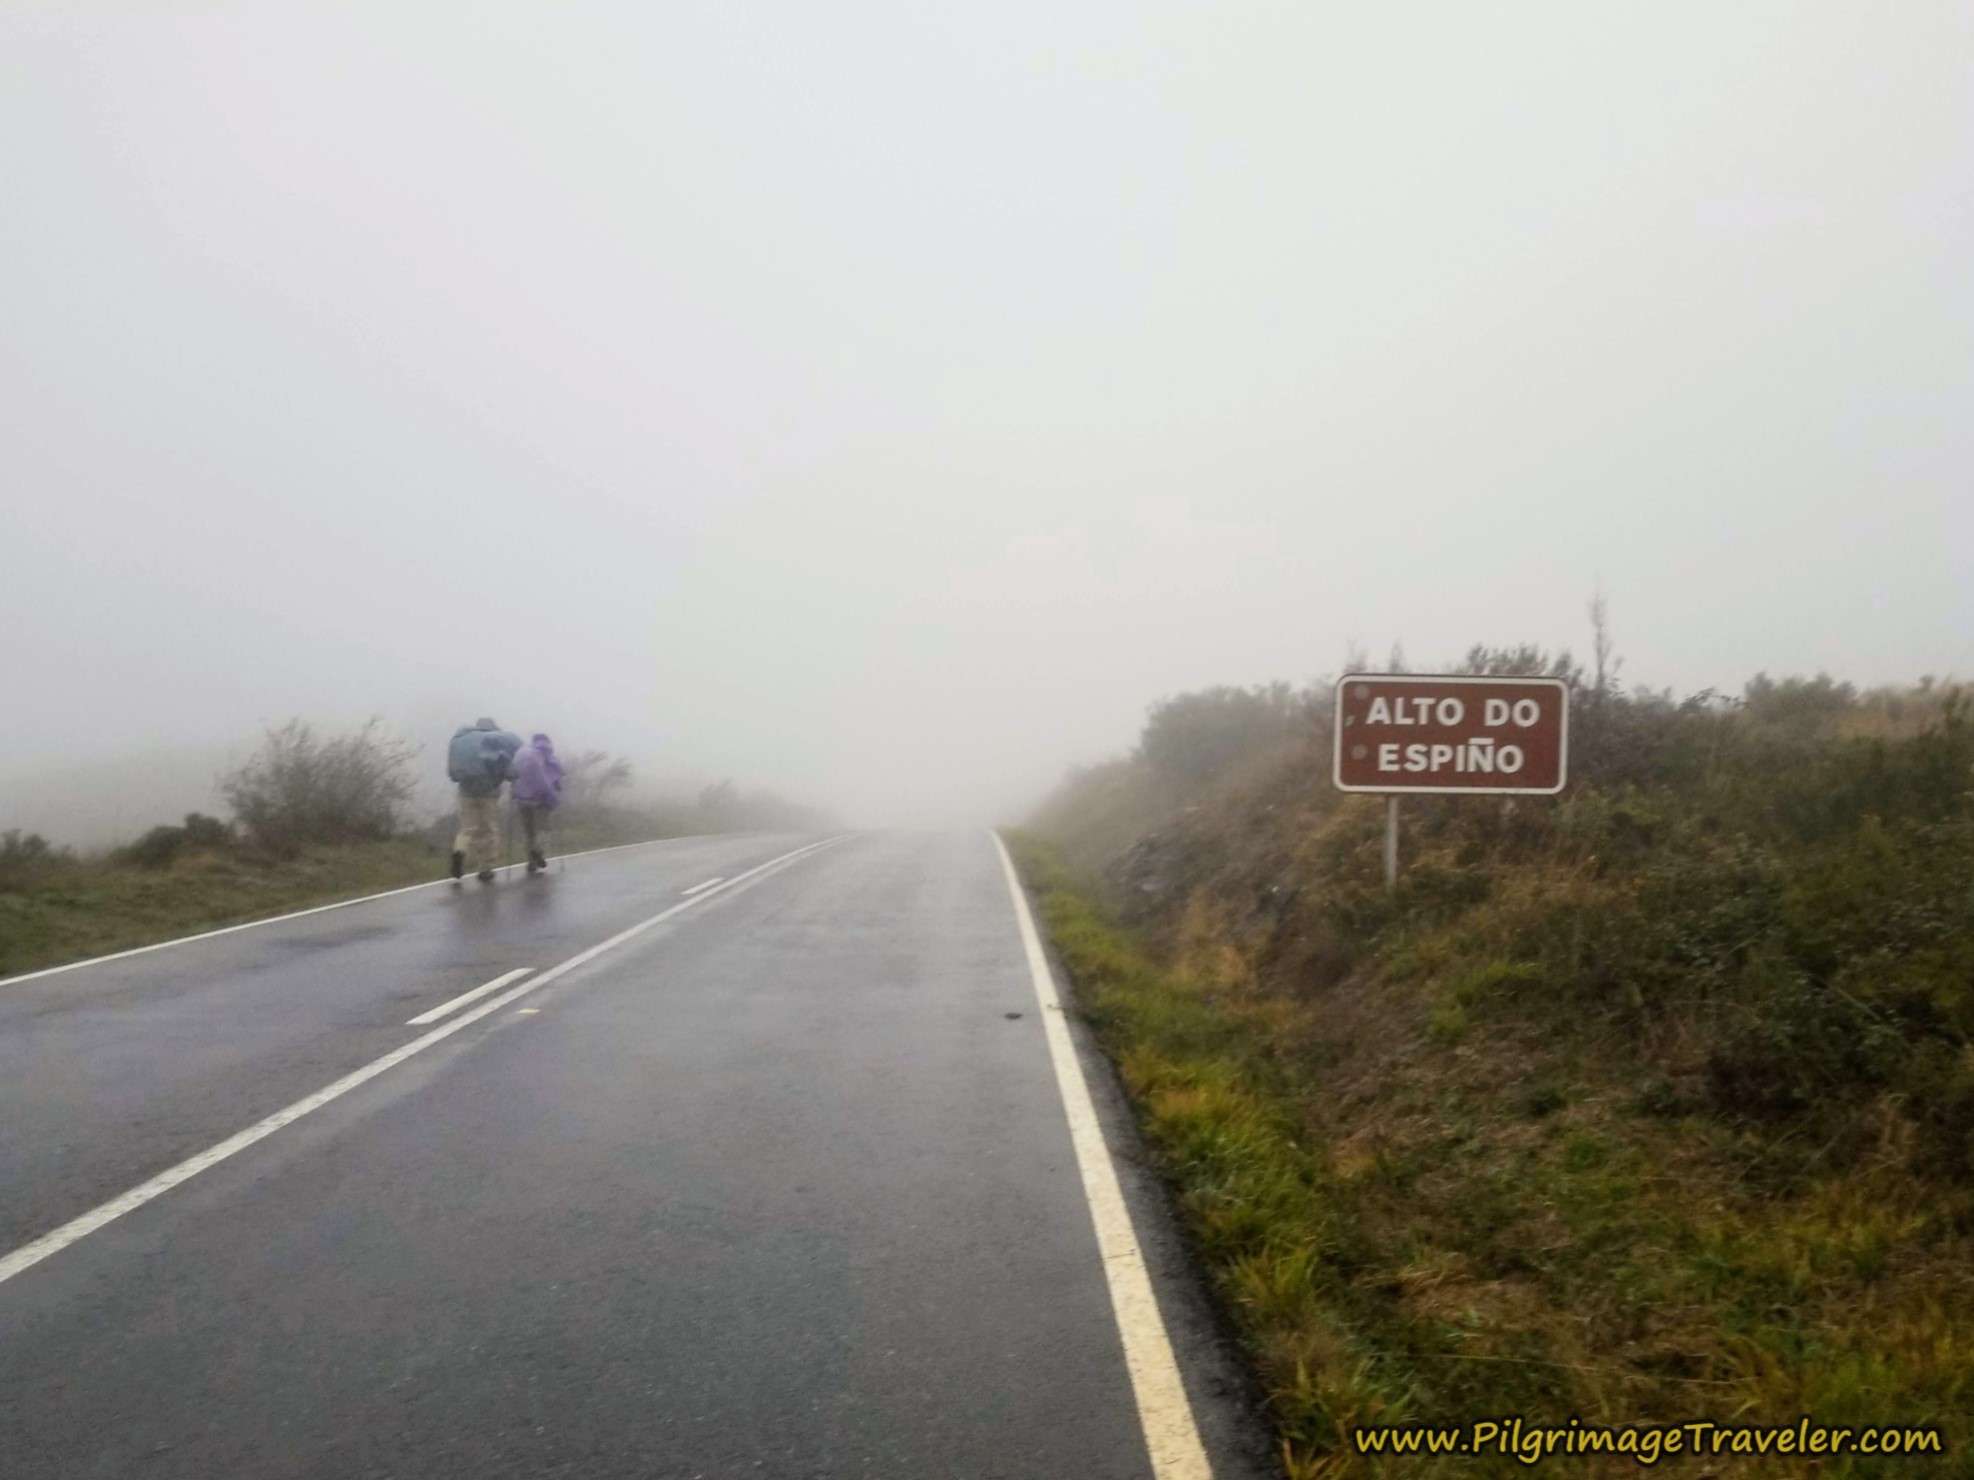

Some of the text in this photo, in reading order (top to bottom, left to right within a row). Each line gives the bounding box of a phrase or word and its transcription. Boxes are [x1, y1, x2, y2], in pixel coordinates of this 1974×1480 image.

[1366, 697, 1540, 728] ALTO DO
[1379, 737, 1523, 773] ESPIÑO
